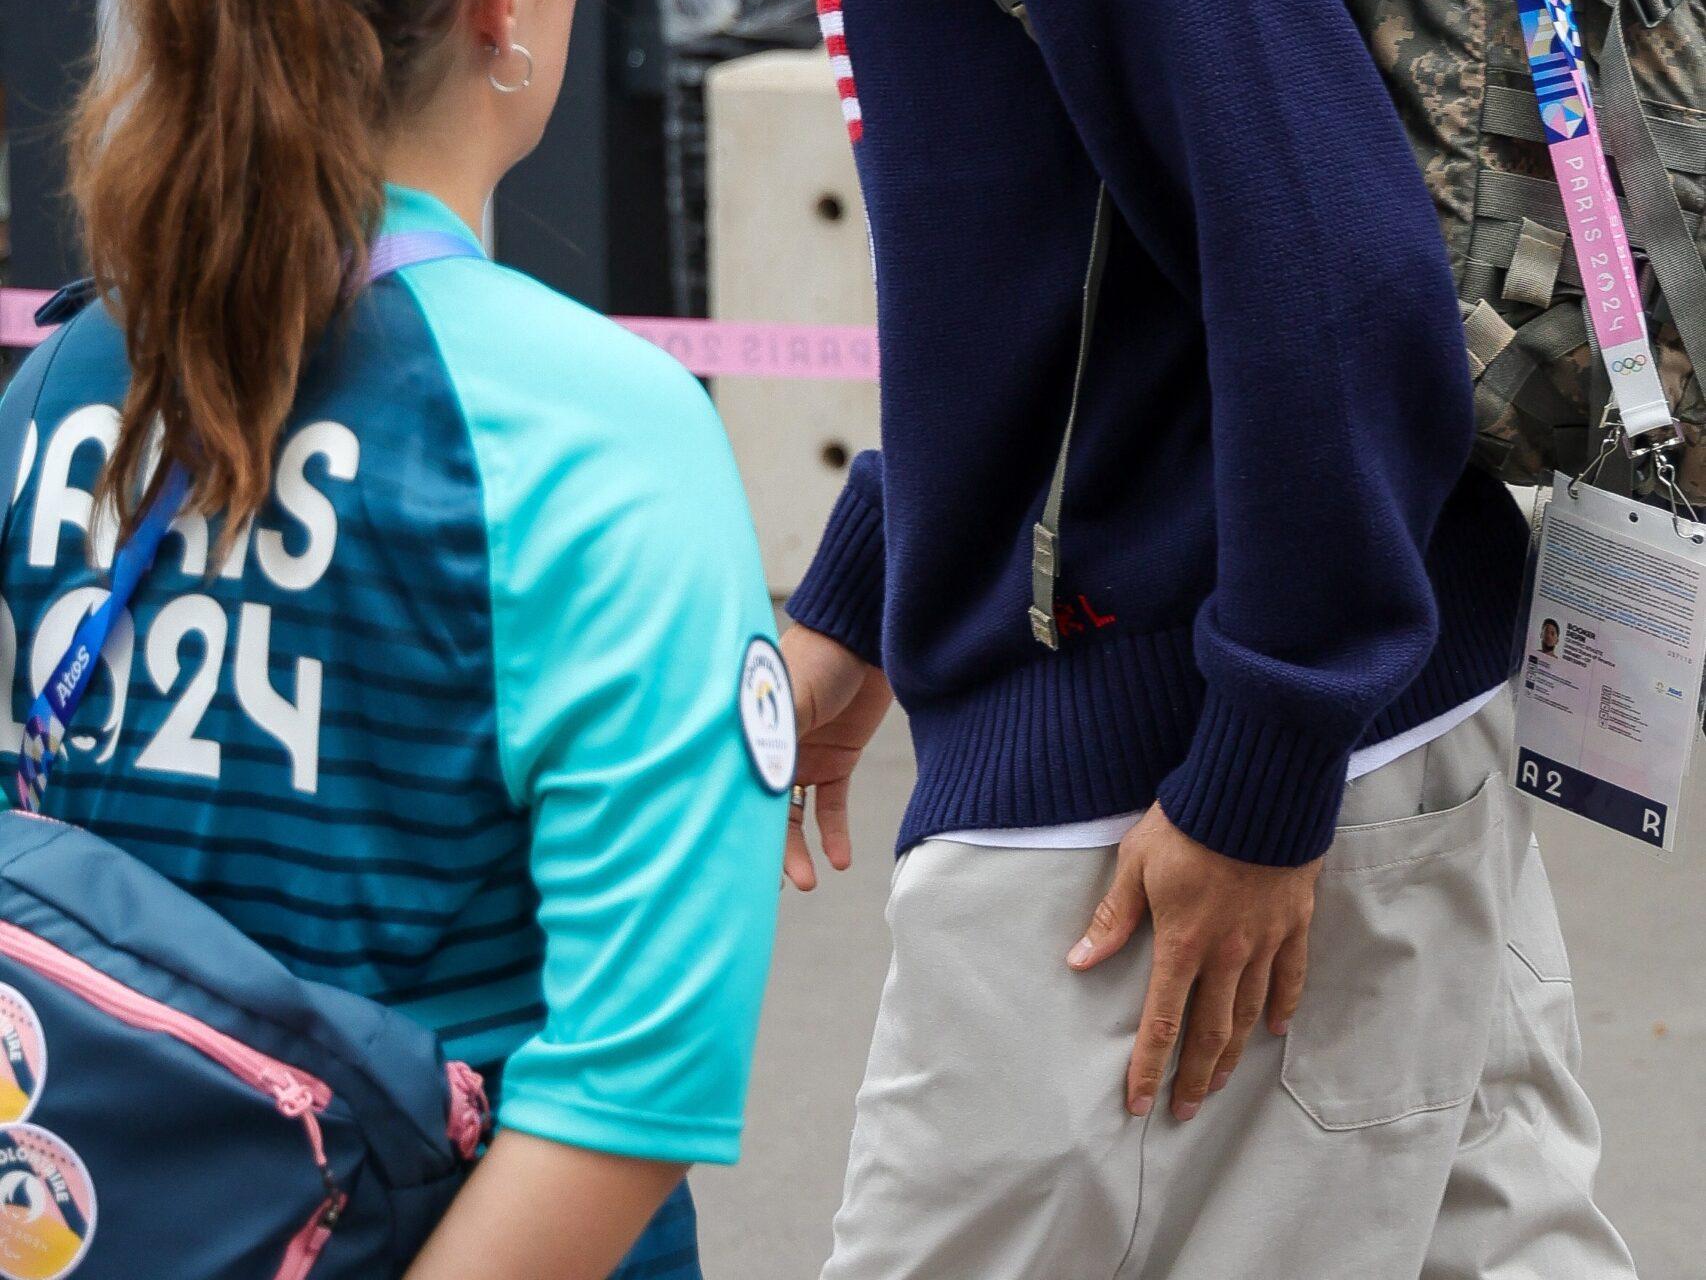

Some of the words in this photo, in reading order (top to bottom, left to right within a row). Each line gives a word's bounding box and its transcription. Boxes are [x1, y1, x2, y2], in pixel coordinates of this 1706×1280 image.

[1566, 156, 1602, 243] PARIS
[1590, 252, 1624, 333] 2024
[53, 644, 91, 709] Atos
[1642, 808, 1661, 838] R
